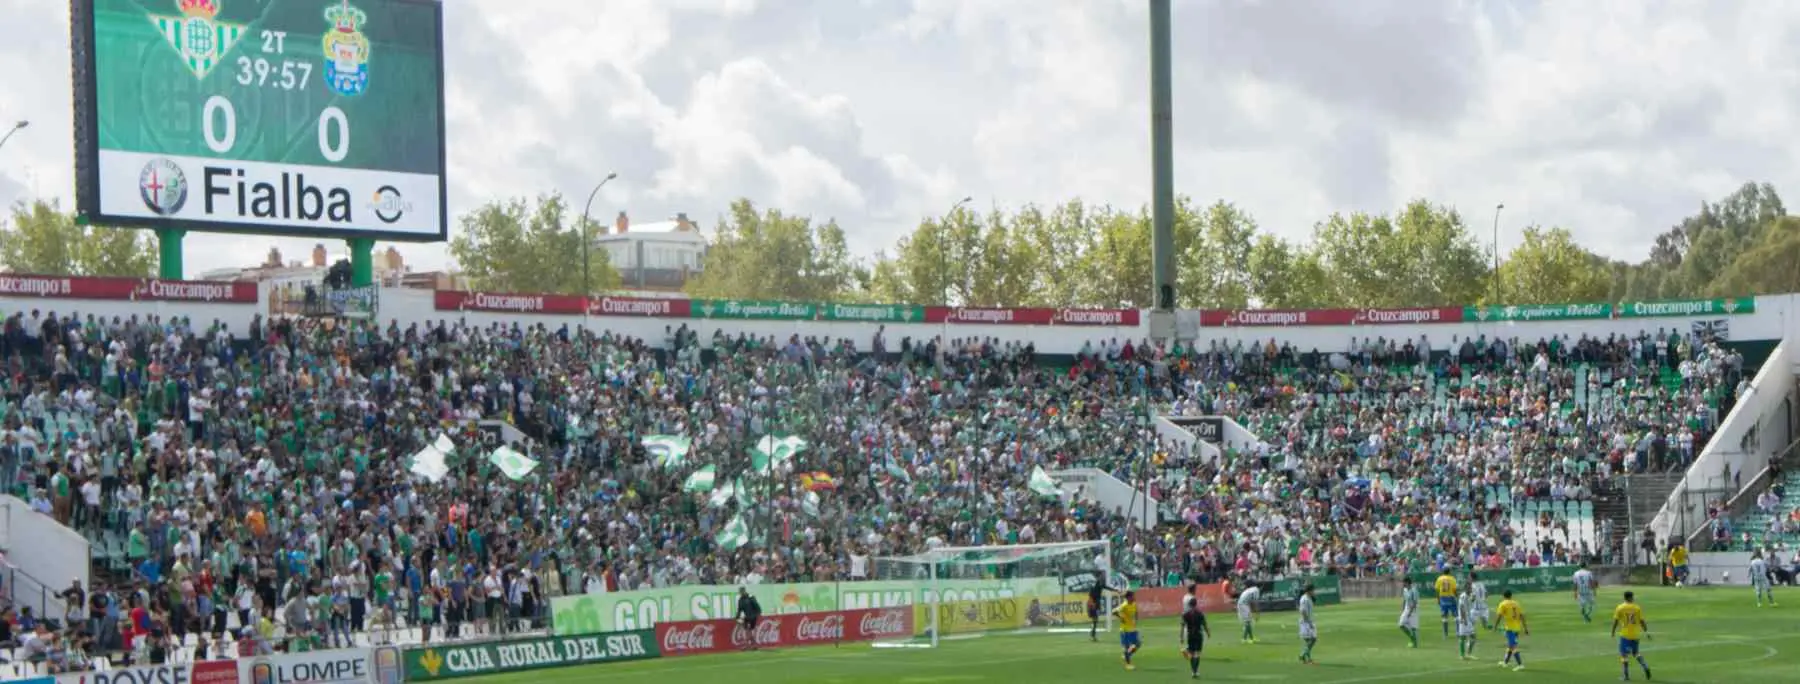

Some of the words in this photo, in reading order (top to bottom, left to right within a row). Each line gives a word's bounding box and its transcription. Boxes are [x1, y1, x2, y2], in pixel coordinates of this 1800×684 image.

[261, 30, 286, 54] 2T
[236, 56, 312, 91] 39:57
[203, 95, 236, 153] 0
[318, 106, 349, 162] 0
[204, 166, 352, 222] Fialba
[0, 277, 60, 296] zcampo
[150, 282, 222, 300] Cruzcampo
[476, 293, 537, 312] Cruzcampo
[602, 297, 662, 315] Cruzcampo
[1634, 300, 1701, 315] Cruzcampo
[958, 308, 1007, 323] Cruzcampo
[1063, 308, 1115, 324] Cruzcampo
[1238, 311, 1297, 325] Cruzcampo
[1368, 309, 1430, 323] Cruzcampo
[446, 648, 495, 671] CAJA
[497, 642, 562, 666] RURAL
[564, 638, 602, 660] DEL
[608, 634, 646, 656] SUR
[278, 658, 366, 683] LOMPE
